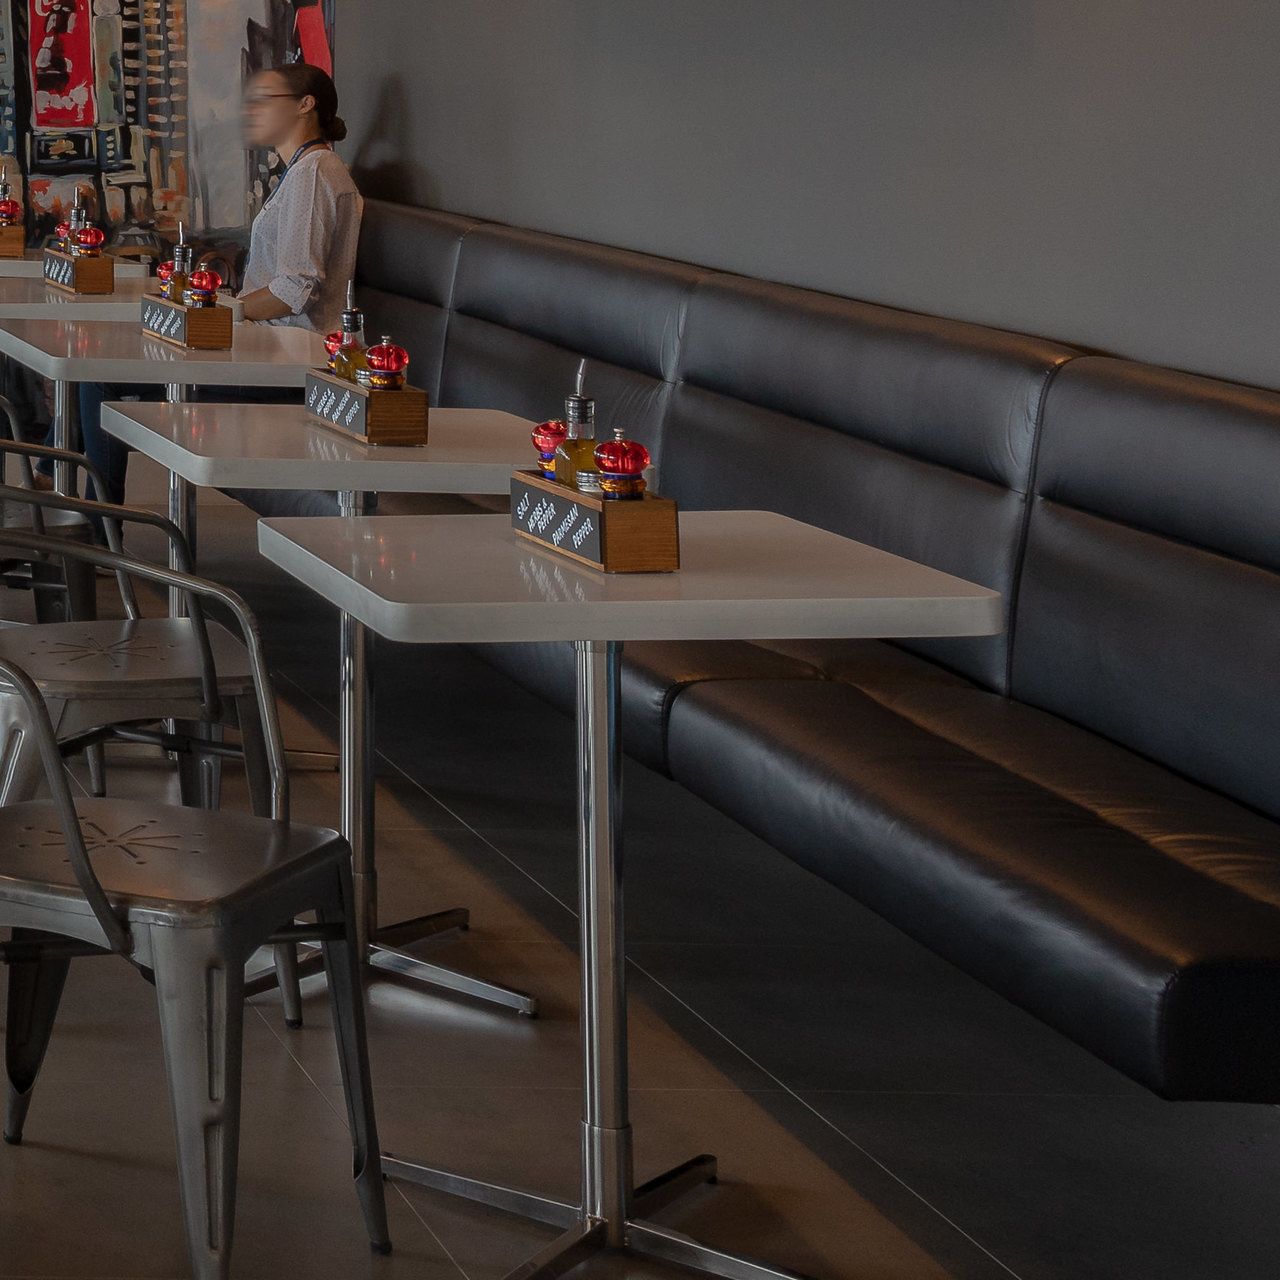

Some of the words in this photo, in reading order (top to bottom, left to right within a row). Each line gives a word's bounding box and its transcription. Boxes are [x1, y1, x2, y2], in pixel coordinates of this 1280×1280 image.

[309, 386, 318, 407] SALT
[516, 492, 530, 520] SALT
[527, 503, 543, 532] HERBS
[537, 503, 557, 535] PEPPER
[552, 504, 579, 547] PARMESAN
[572, 517, 594, 549] PEPPER
